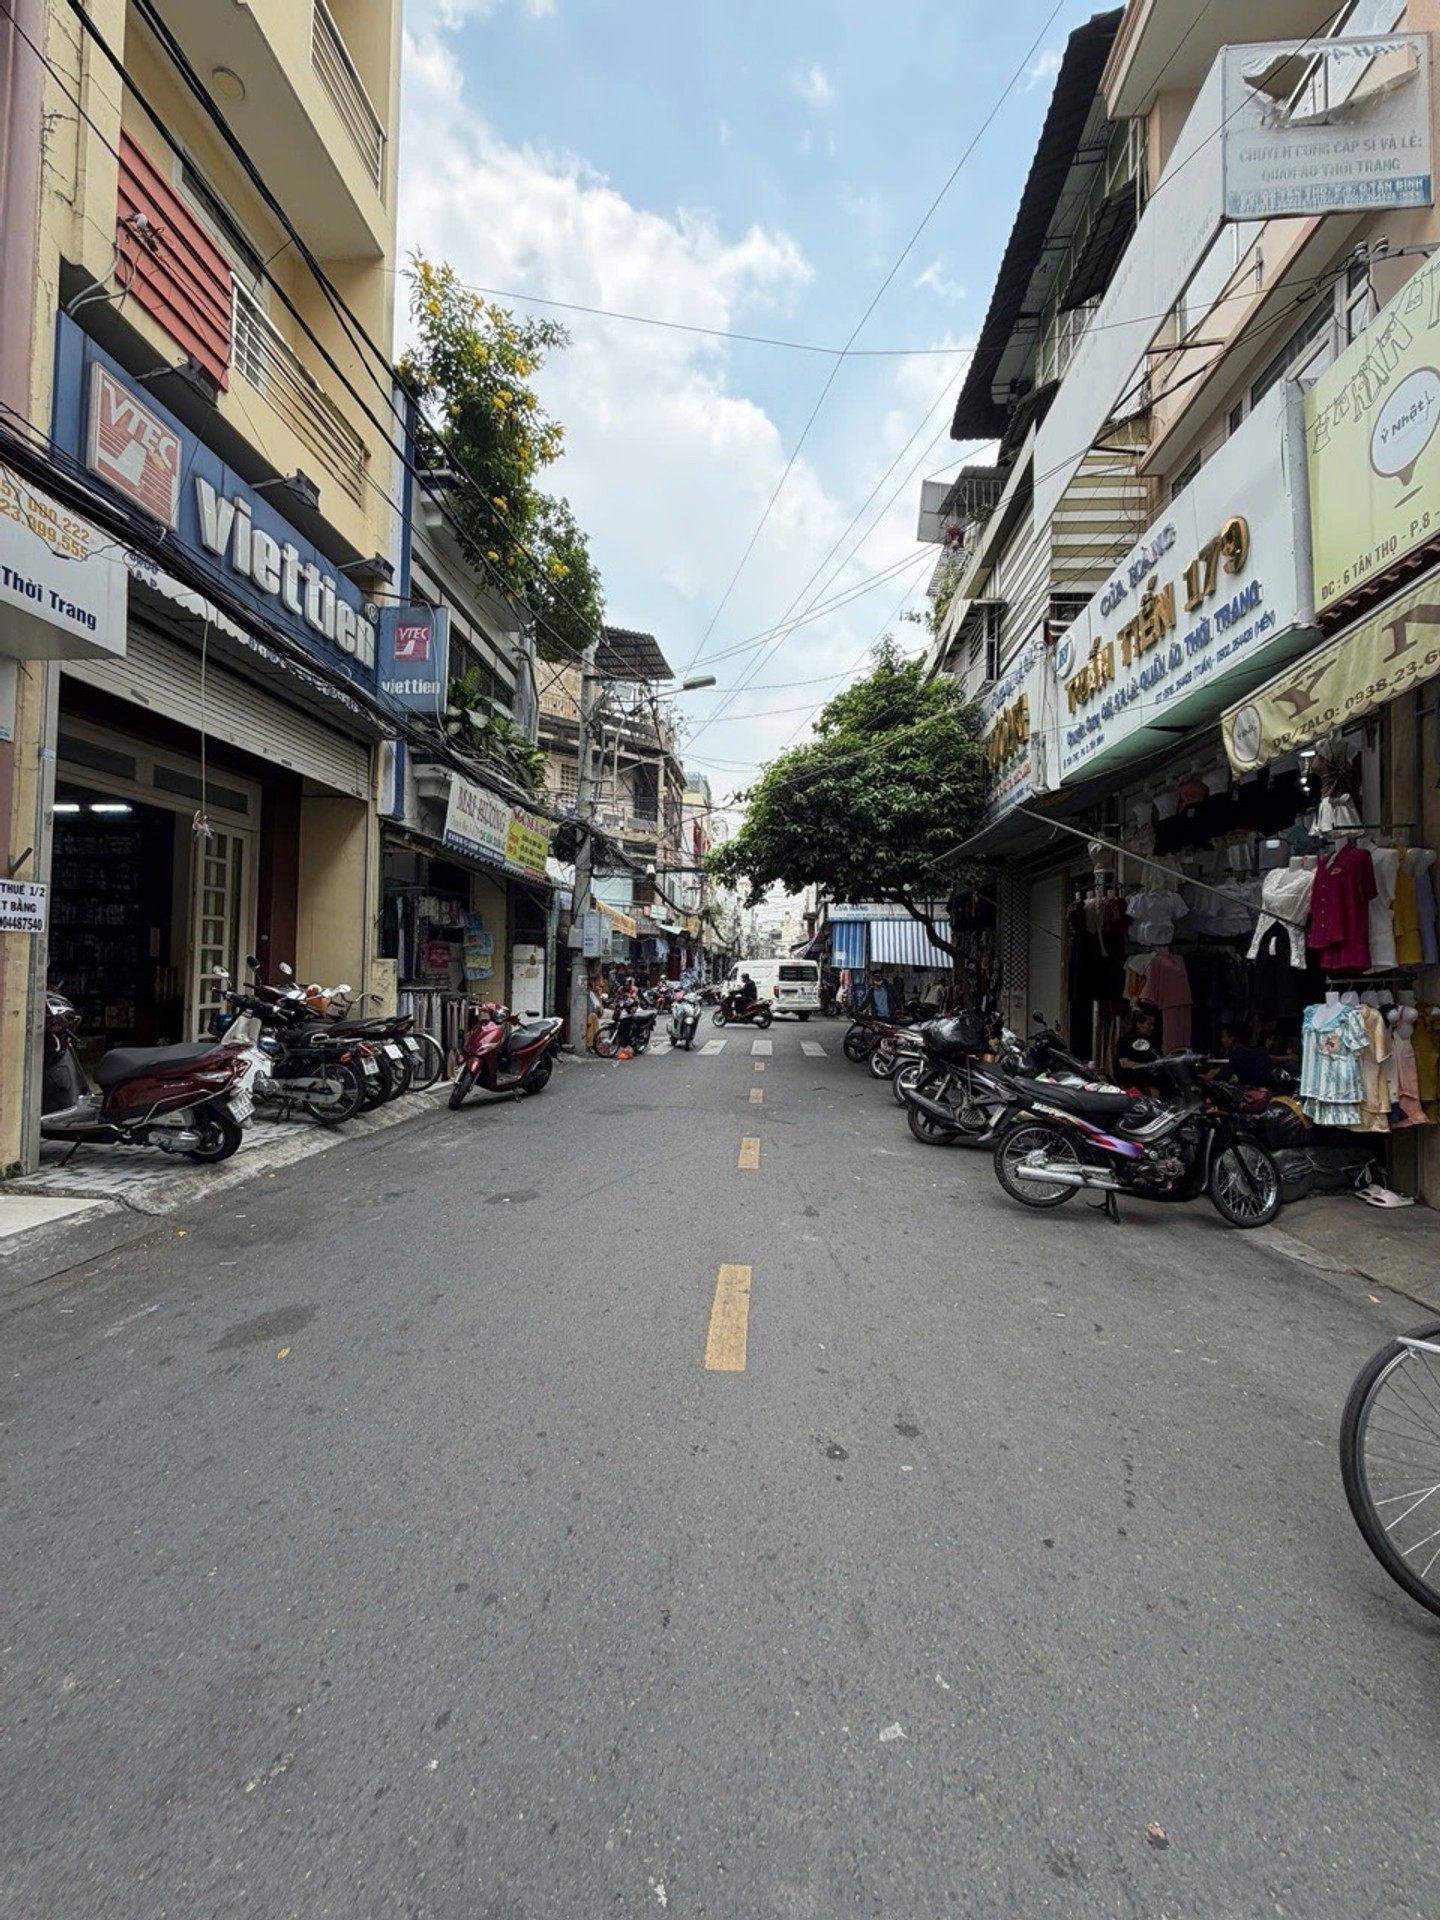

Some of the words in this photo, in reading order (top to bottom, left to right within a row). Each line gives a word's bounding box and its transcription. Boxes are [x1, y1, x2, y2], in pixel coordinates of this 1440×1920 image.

[1356, 157, 1401, 173] TRANG
[103, 377, 178, 471] VTEC
[1182, 515, 1250, 613] 179
[1343, 570, 1350, 585] 6
[1352, 554, 1372, 578] TÂN
[1375, 535, 1398, 562] THỌ
[1410, 511, 1431, 538] P.8
[1, 565, 43, 602] Thời
[49, 589, 97, 631] Trang
[1213, 578, 1263, 633] TRANG
[398, 627, 429, 641] VTEC
[381, 678, 441, 695] viettien
[1344, 649, 1440, 711] 0938.23.6
[29, 885, 46, 897] 1/2
